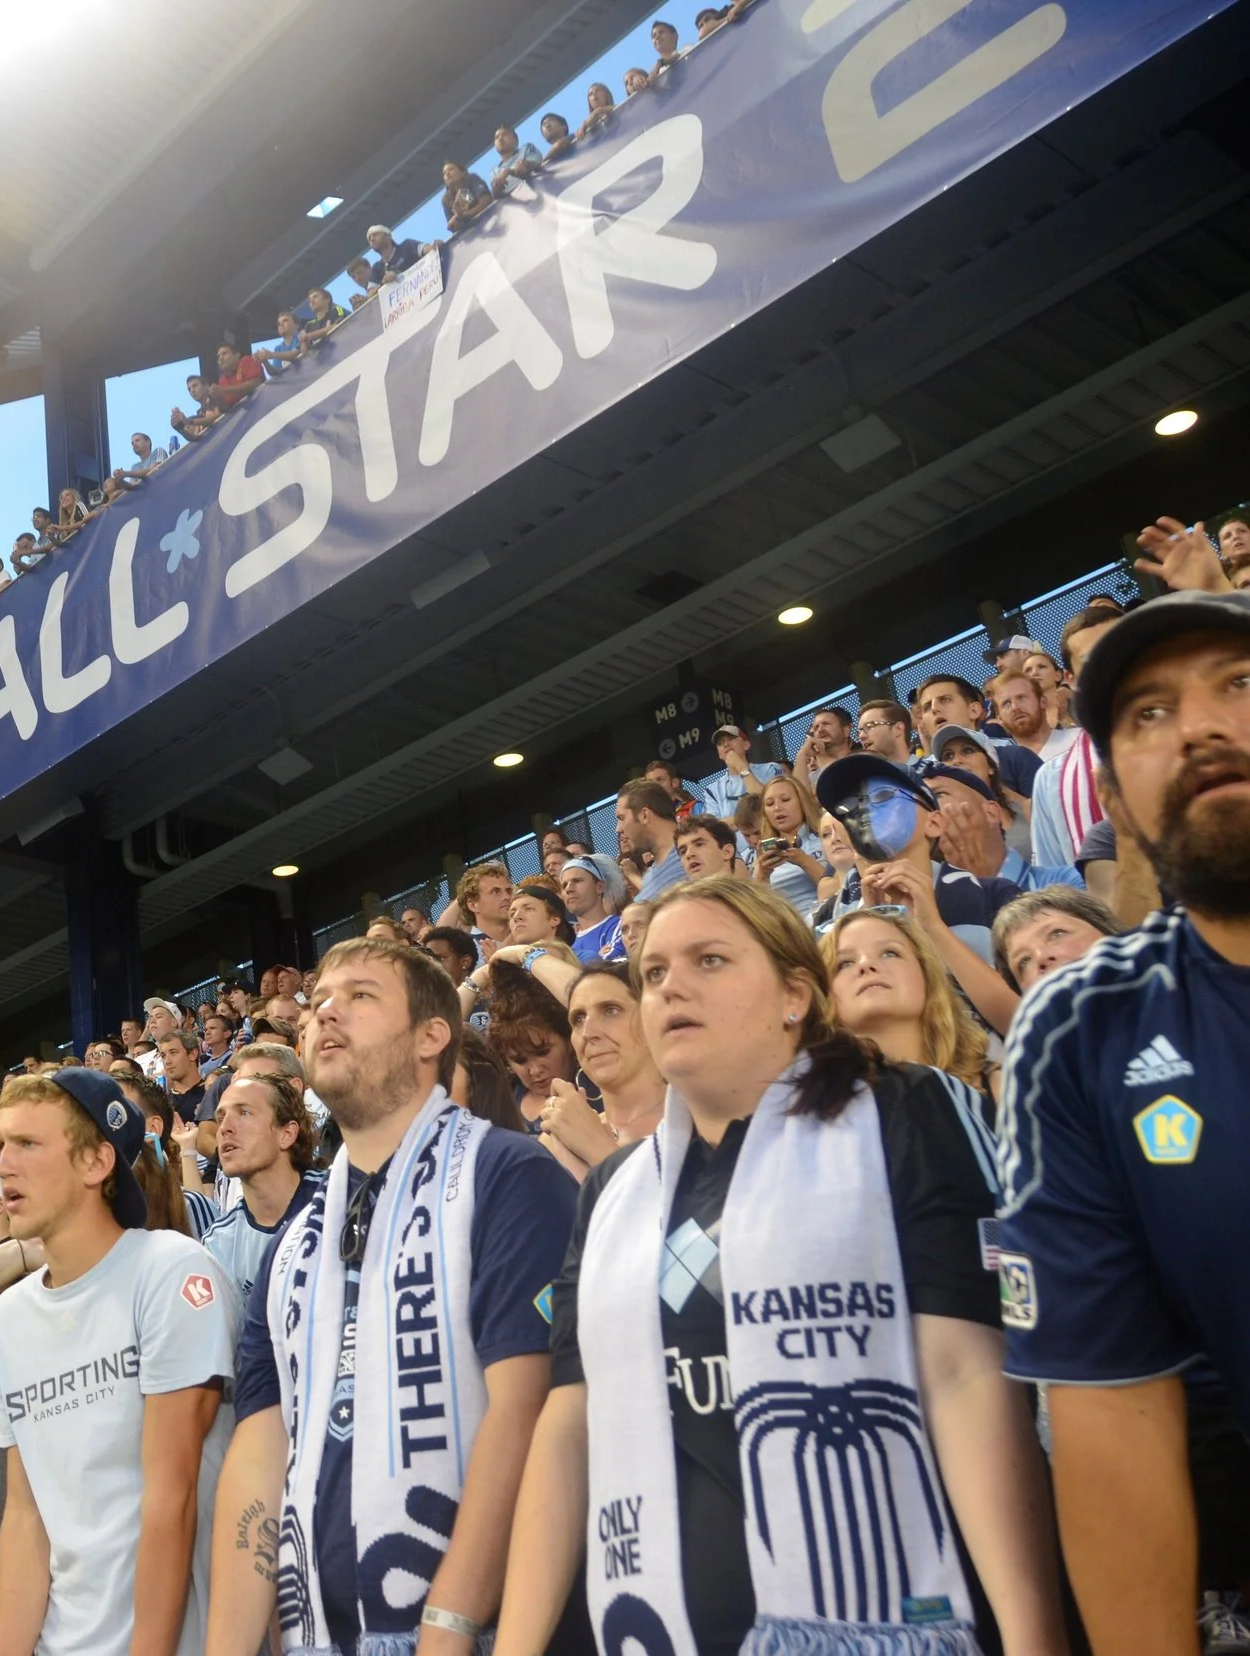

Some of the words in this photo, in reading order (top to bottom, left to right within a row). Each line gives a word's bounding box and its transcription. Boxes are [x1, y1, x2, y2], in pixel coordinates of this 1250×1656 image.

[218, 113, 718, 598] STAR
[655, 703, 677, 724] M8
[711, 687, 733, 710] M8
[678, 727, 700, 749] M9
[1154, 1113, 1188, 1147] K
[187, 1278, 211, 1302] K
[731, 1281, 896, 1325] KANSAS
[776, 1324, 871, 1360] CITY
[6, 1345, 140, 1424] SPORTING
[34, 1399, 80, 1423] KANSAS
[85, 1385, 115, 1405] CITY
[599, 1495, 643, 1543] ONLY
[604, 1537, 643, 1581] ONE
